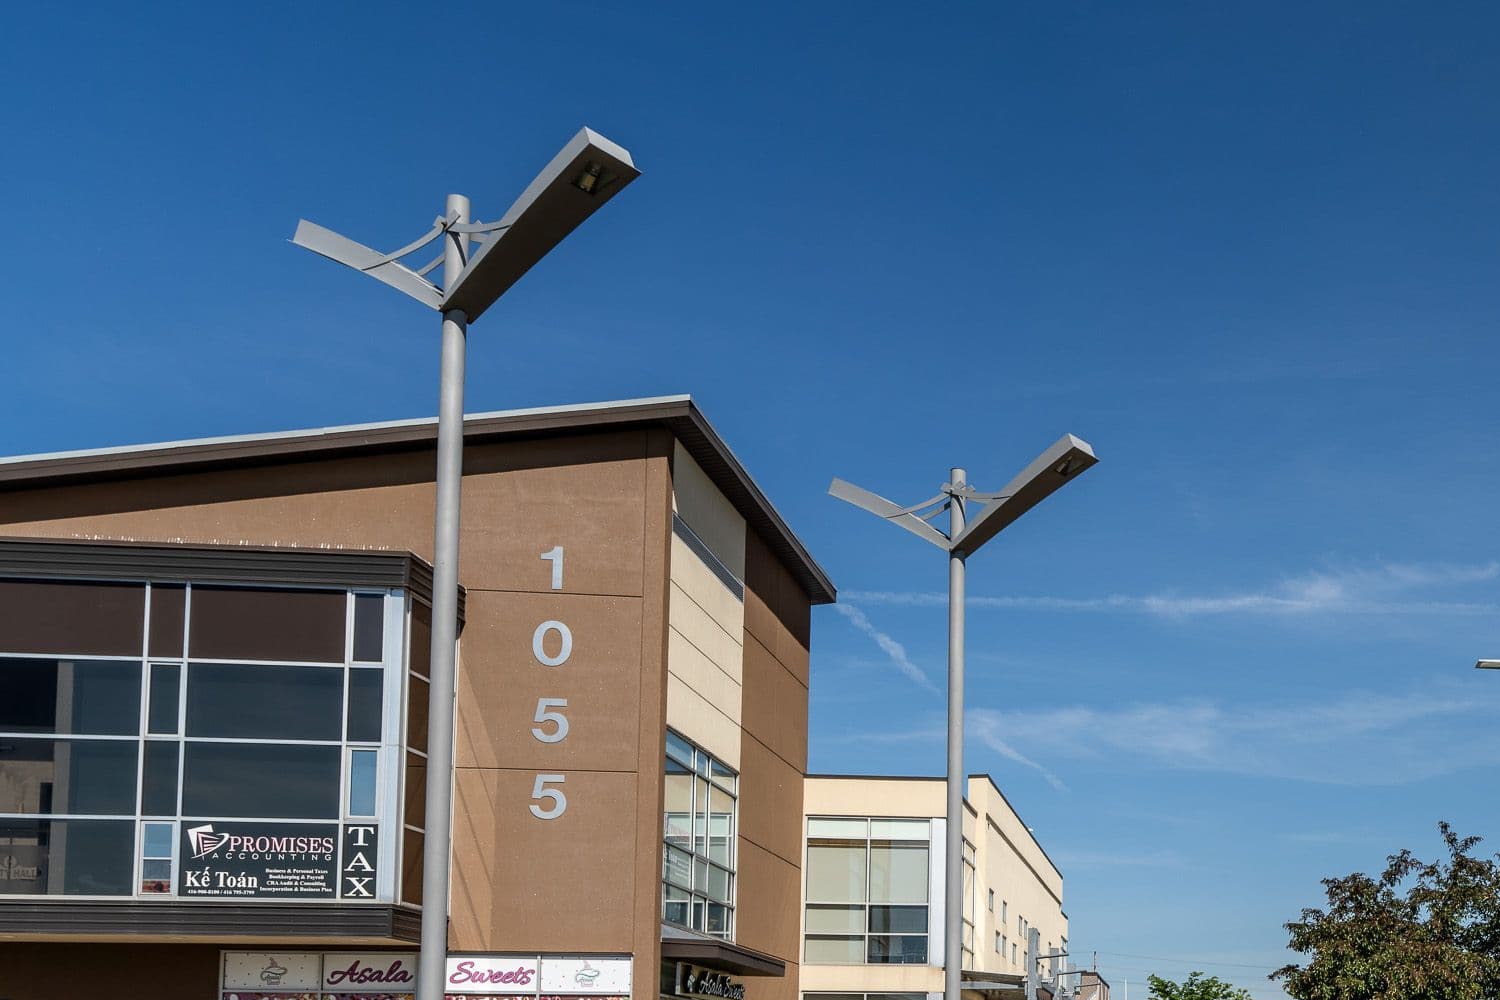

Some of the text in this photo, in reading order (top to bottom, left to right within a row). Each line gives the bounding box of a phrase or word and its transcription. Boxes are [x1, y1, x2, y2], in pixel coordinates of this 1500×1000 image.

[529, 546, 572, 820] 1055
[212, 852, 332, 861] ACCOUNTING
[228, 836, 334, 853] PROMISES
[344, 826, 375, 897] TAX
[185, 866, 258, 888] Kế Toán
[326, 960, 536, 986] Asala Sweets
[699, 970, 722, 994] Asala
